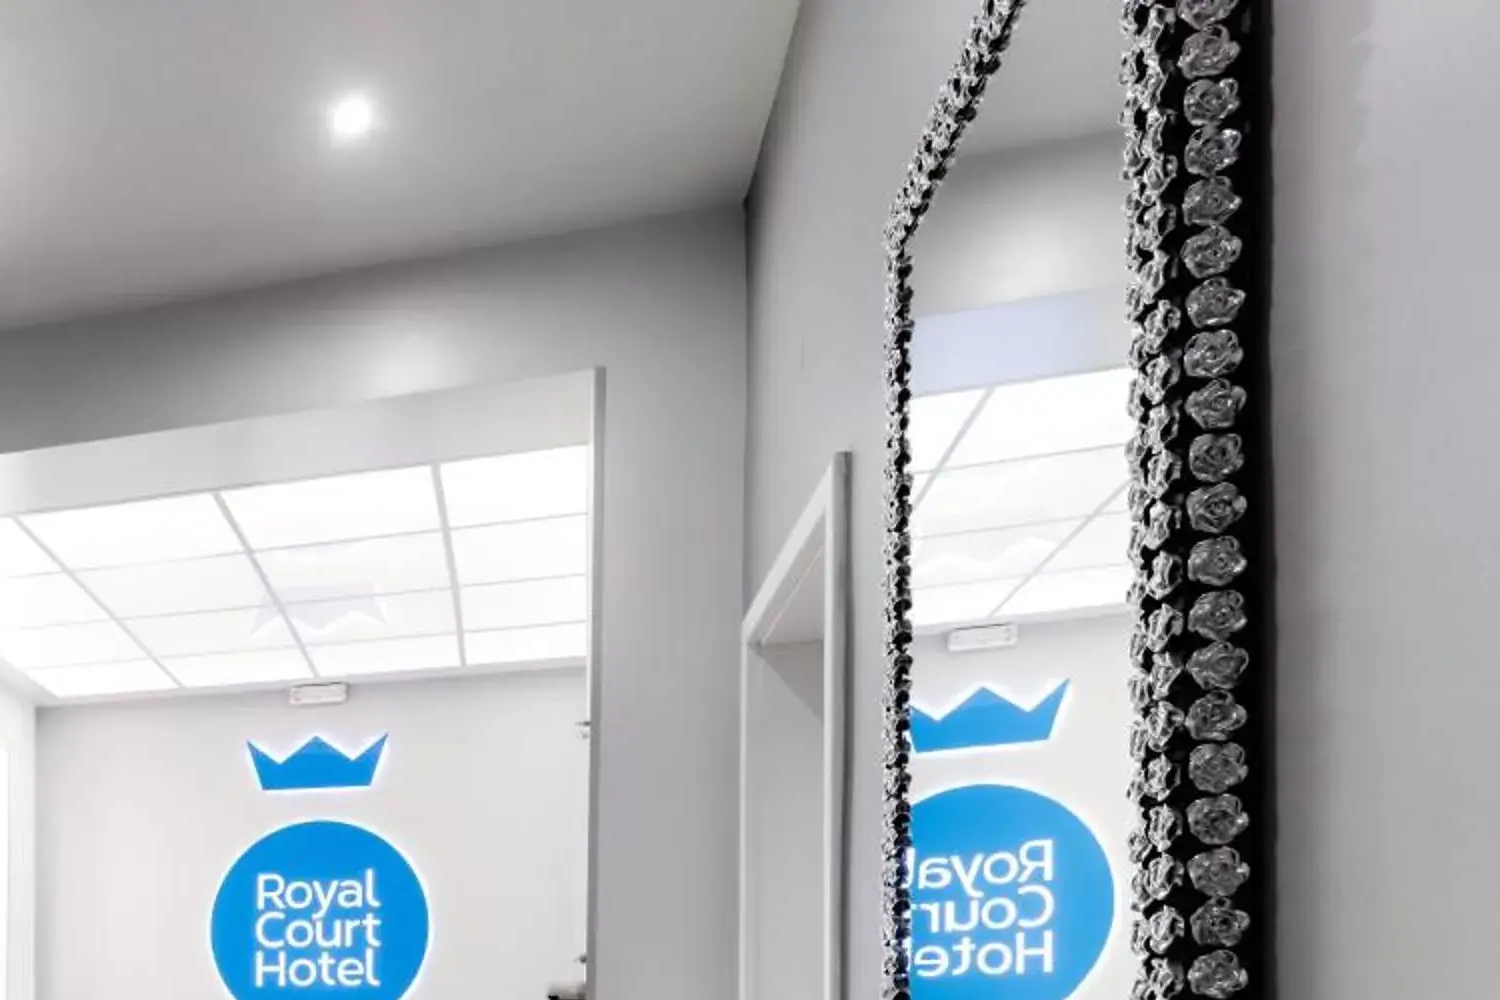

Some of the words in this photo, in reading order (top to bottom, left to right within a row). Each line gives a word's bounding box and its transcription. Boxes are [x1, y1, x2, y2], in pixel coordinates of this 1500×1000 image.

[257, 868, 381, 919] Royal
[255, 911, 381, 948] Court
[255, 948, 380, 987] Hotel
